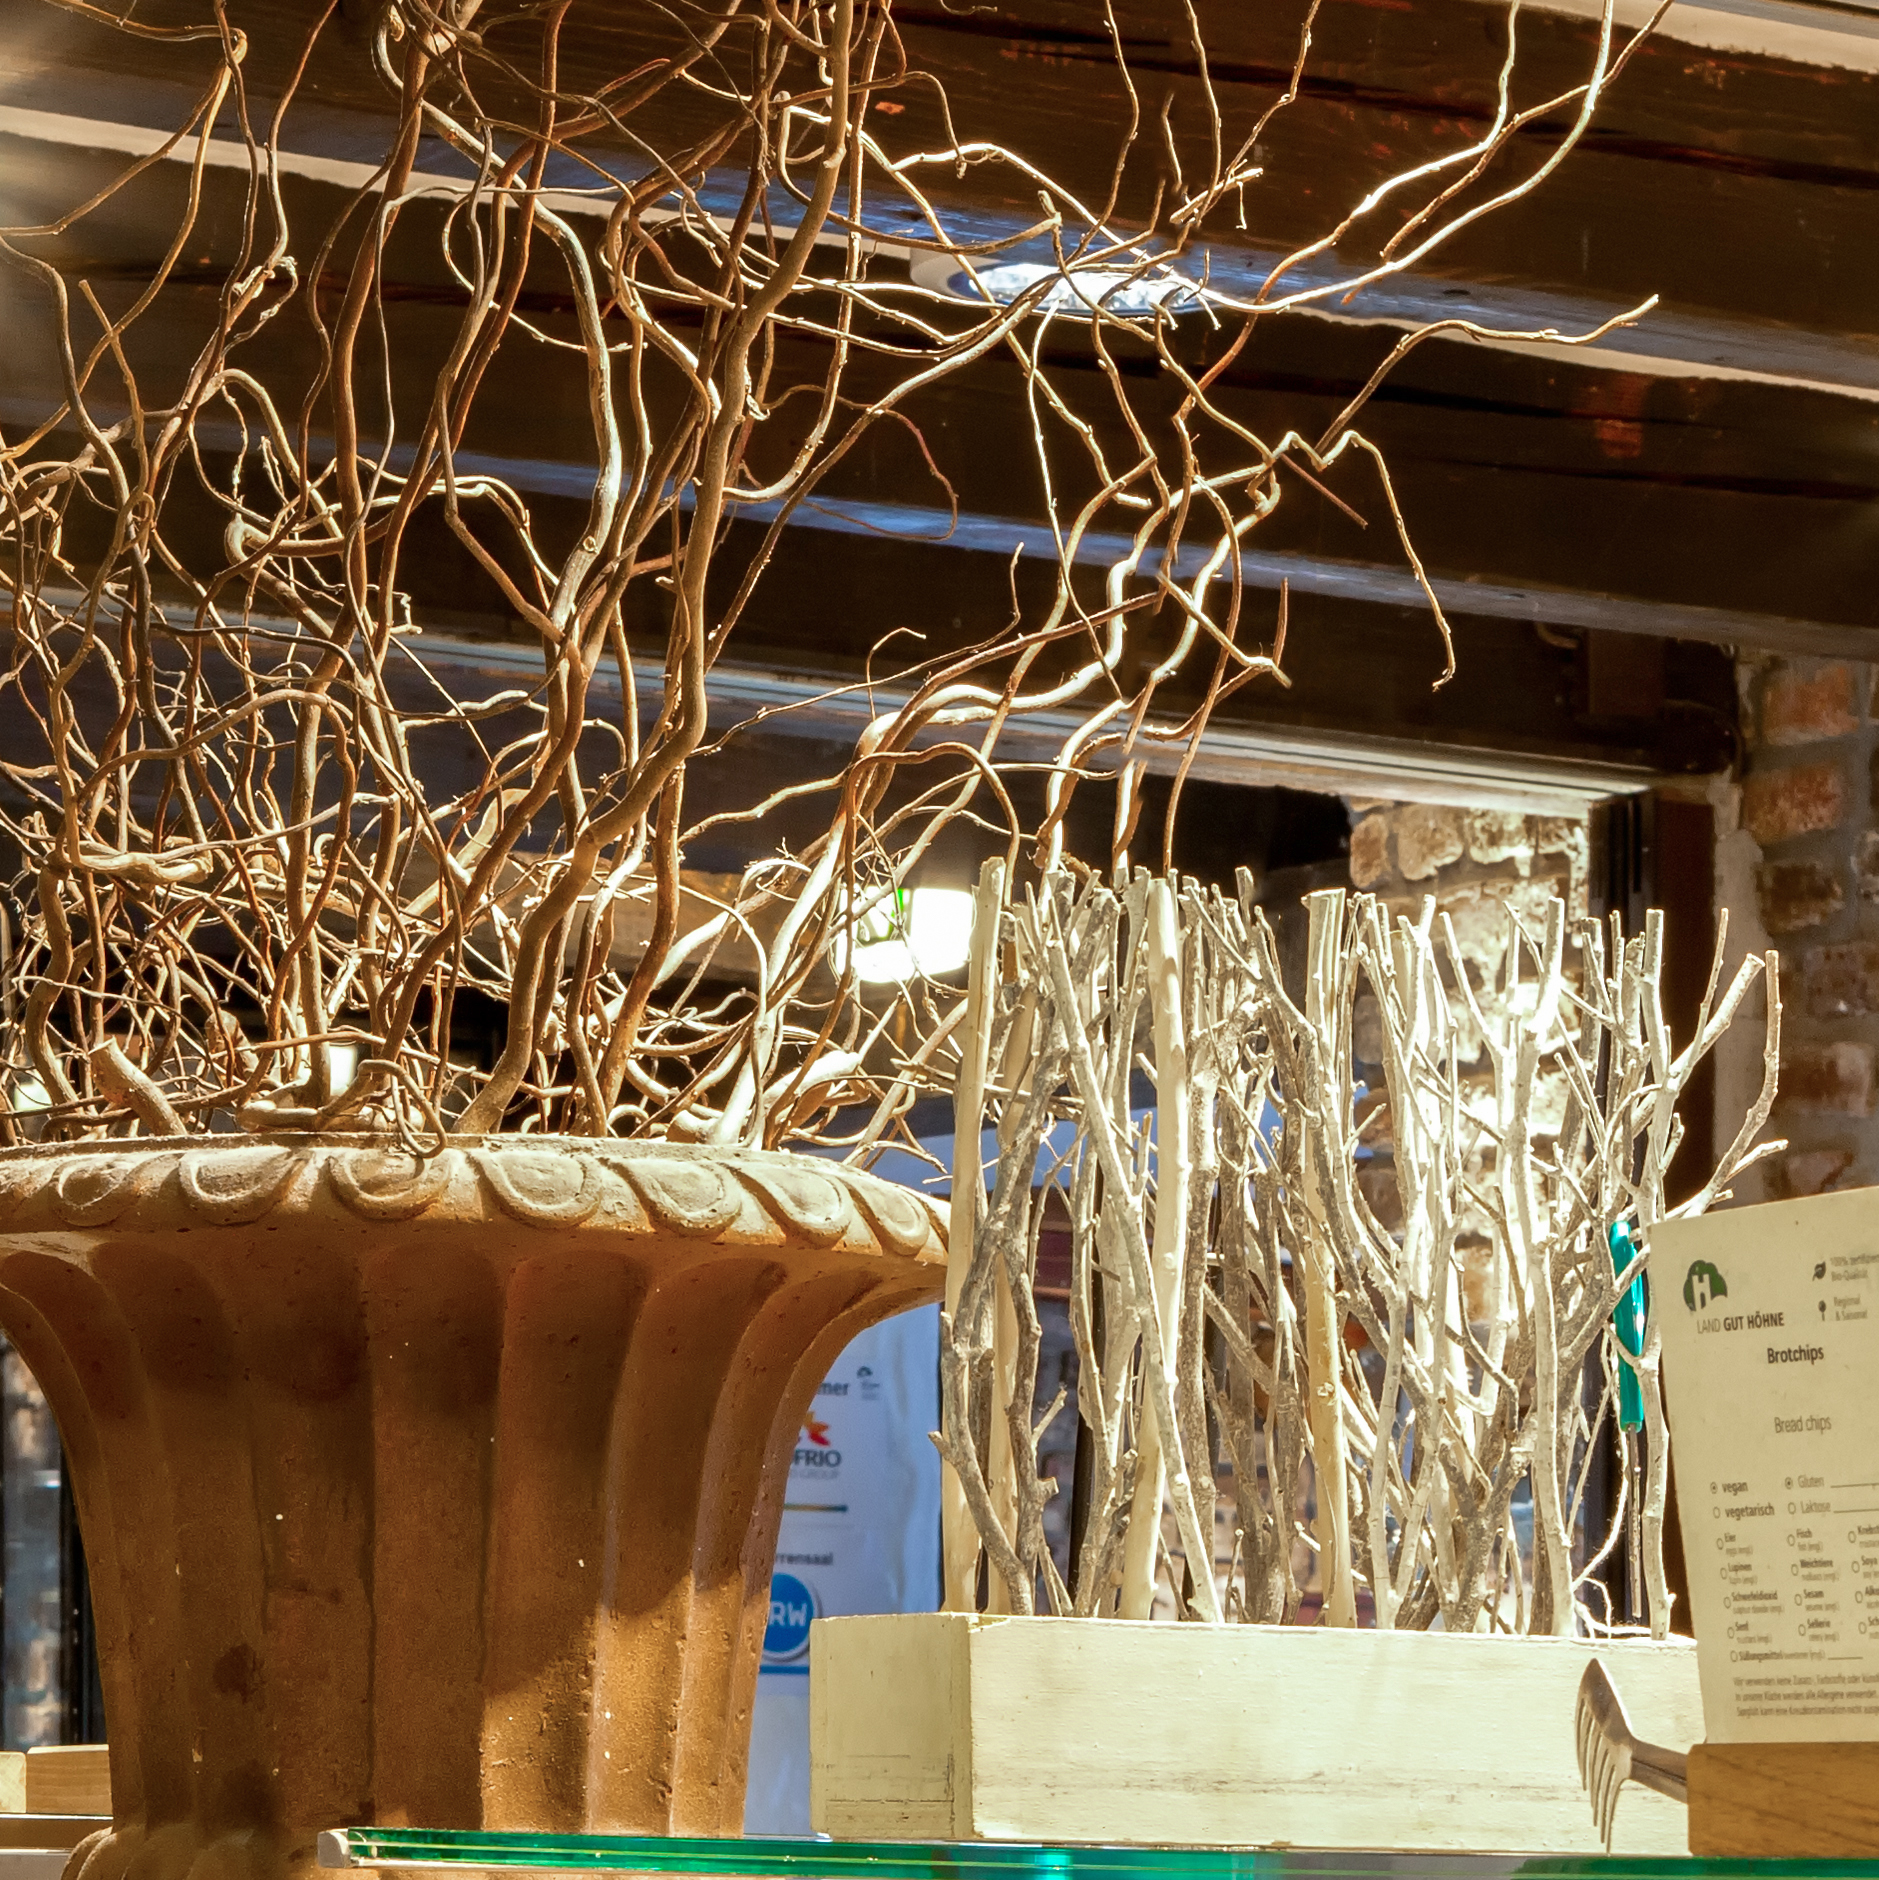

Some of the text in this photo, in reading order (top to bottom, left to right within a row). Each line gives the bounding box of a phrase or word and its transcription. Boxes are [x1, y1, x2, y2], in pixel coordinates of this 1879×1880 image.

[1697, 1311, 1784, 1334] LAND GUT HÖHNE
[1767, 1344, 1824, 1365] Brotchips
[1774, 1415, 1832, 1435] Bread chips
[1722, 1474, 1824, 1496] vegan Gluten
[1725, 1501, 1831, 1521] vegetarisch Laktose
